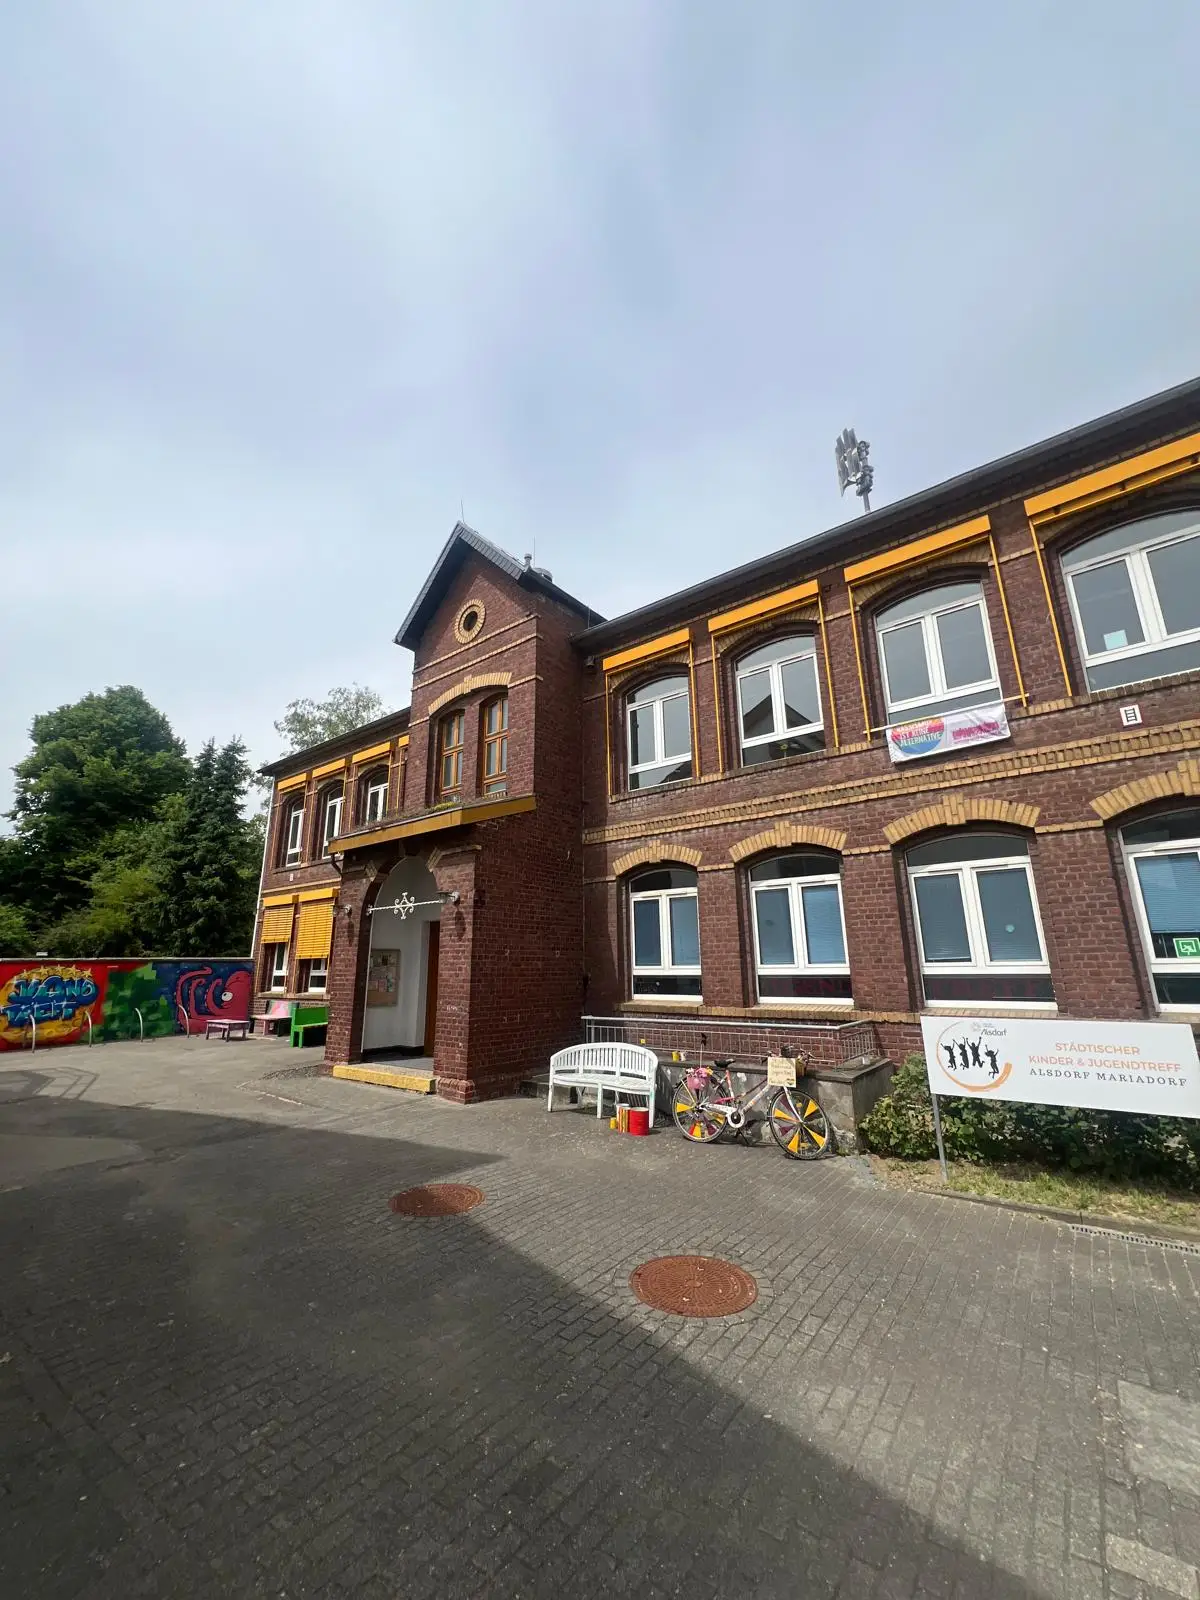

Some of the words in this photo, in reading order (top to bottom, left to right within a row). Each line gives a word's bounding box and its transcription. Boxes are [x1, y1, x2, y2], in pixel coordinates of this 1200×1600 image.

[900, 731, 942, 747] ALTERNATIVE
[981, 1028, 1007, 1036] Alsdorf
[1055, 1042, 1140, 1056] STÄDTISCHER
[1029, 1055, 1073, 1065] KINDER
[1077, 1057, 1084, 1066] &
[1088, 1058, 1181, 1072] JUGENDTREFF
[1029, 1068, 1090, 1079] ALSDORF
[1096, 1072, 1187, 1086] MARIADORF
